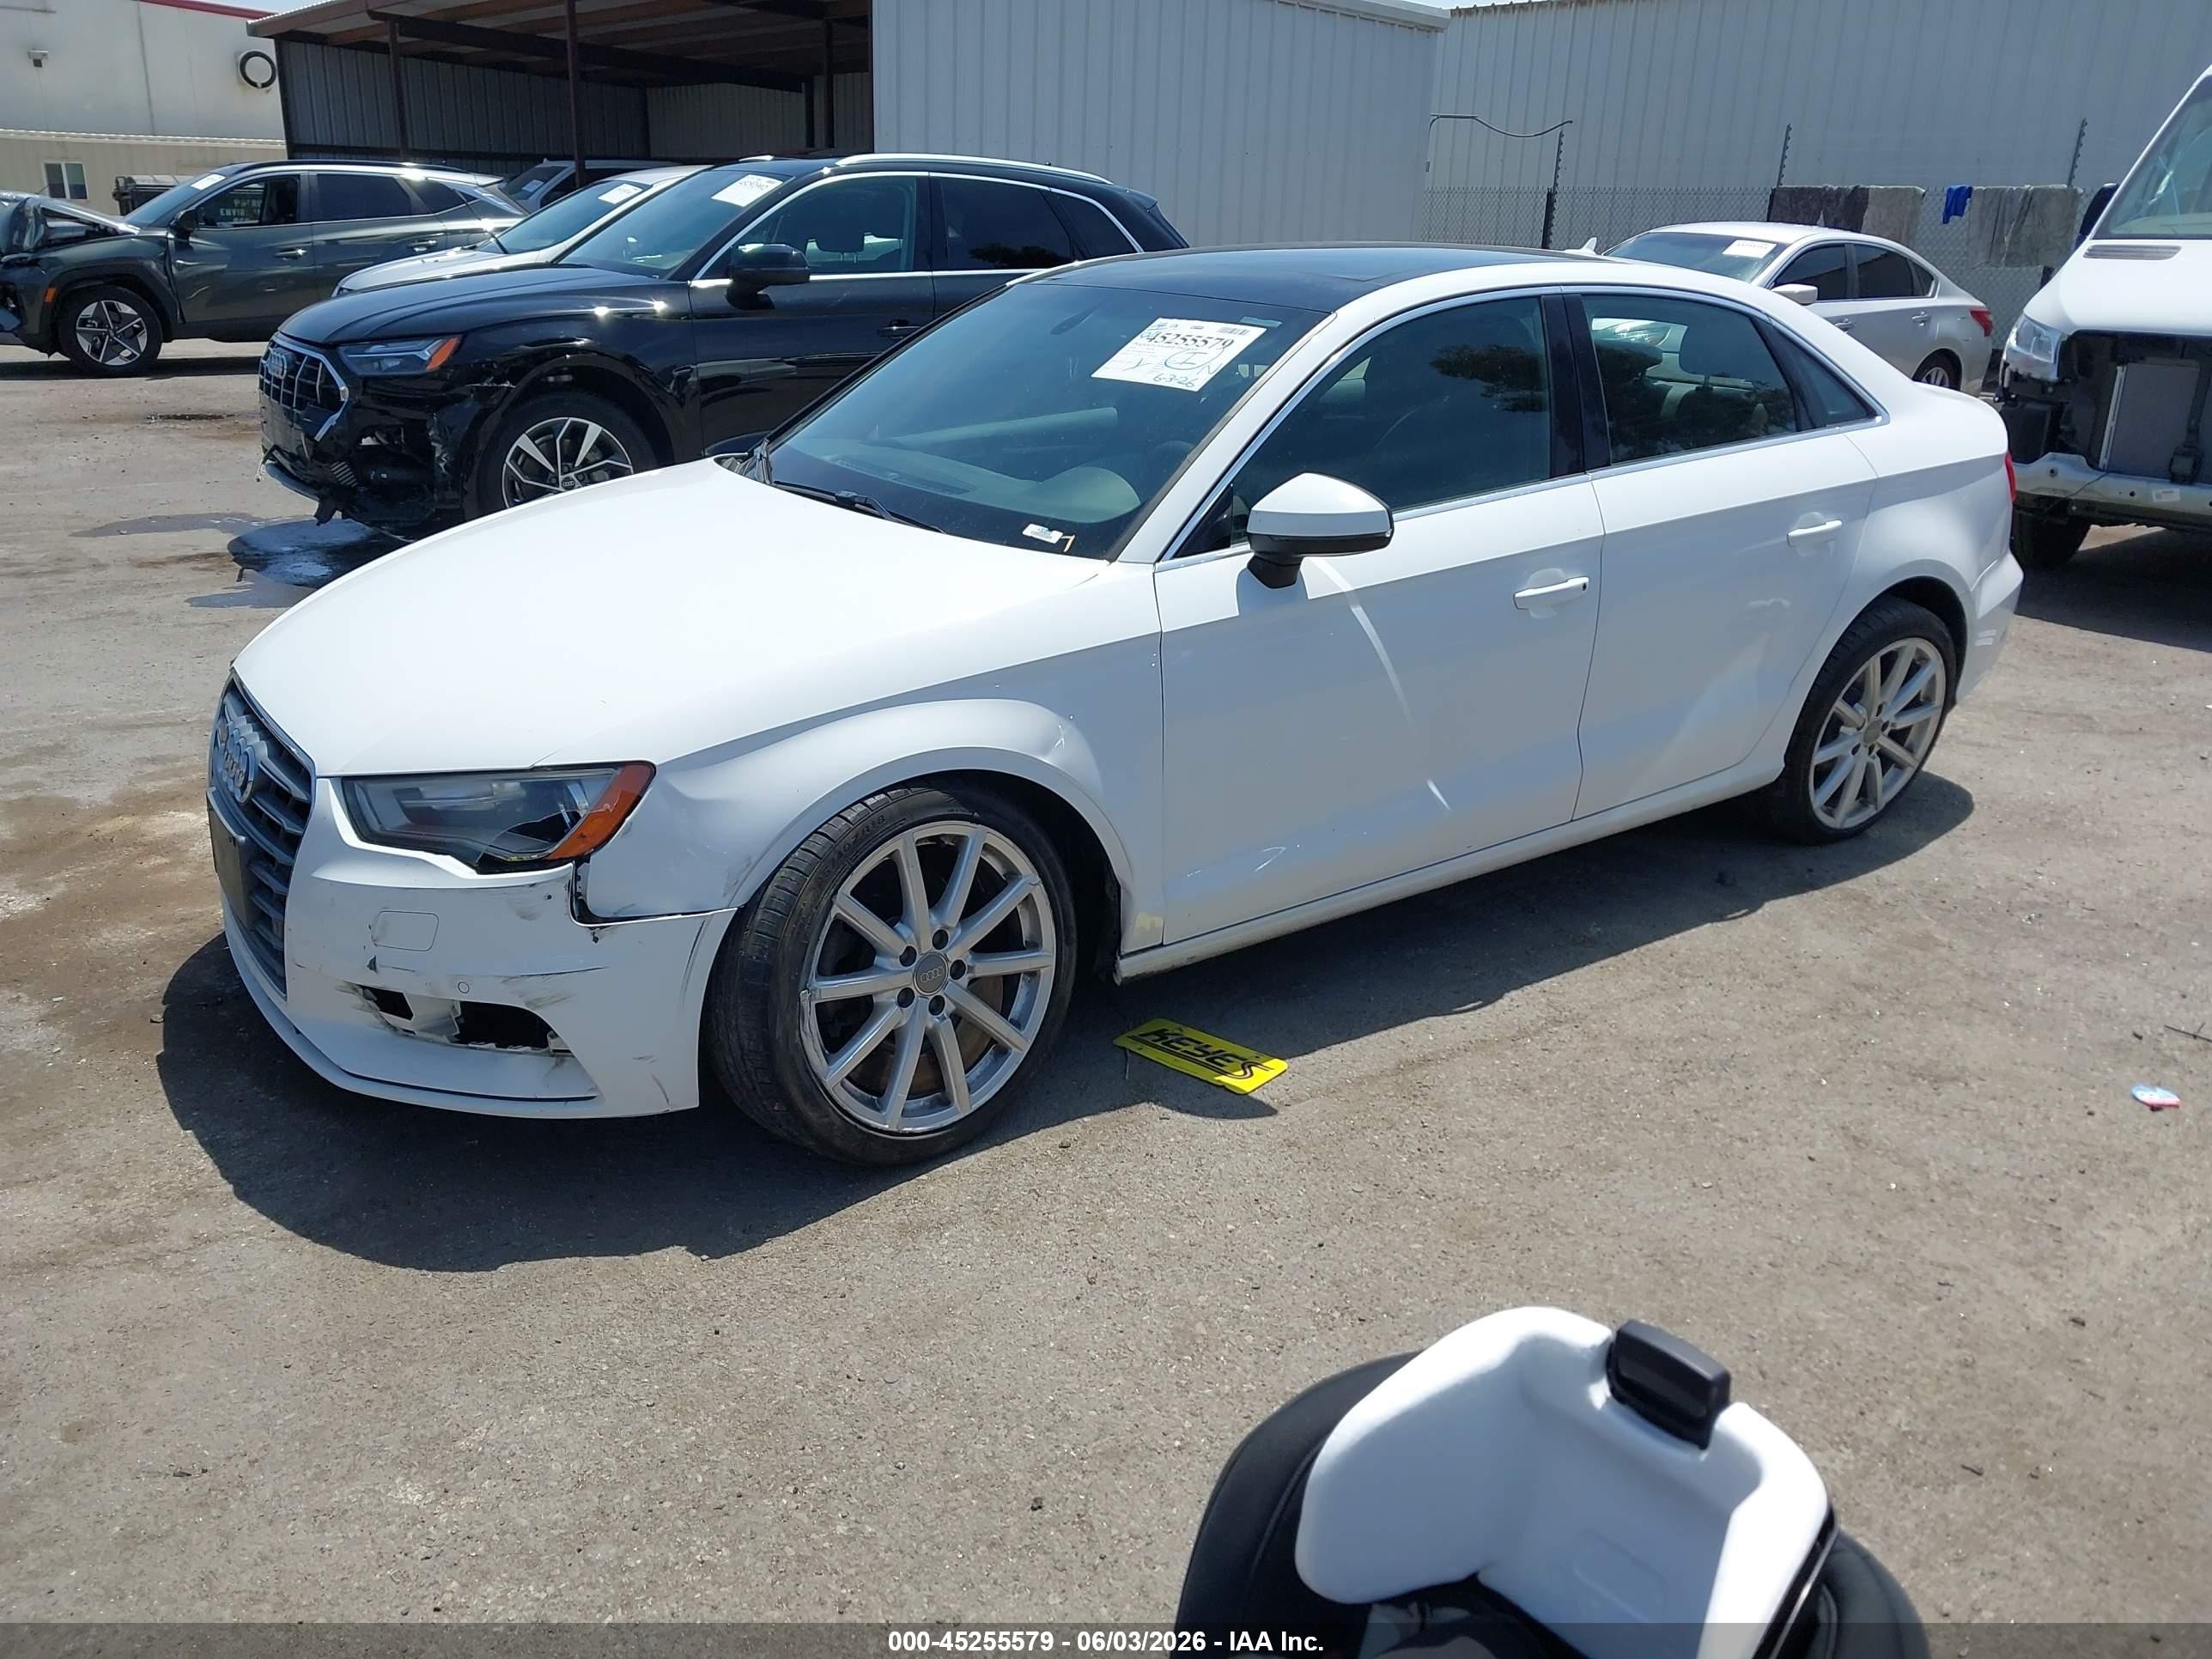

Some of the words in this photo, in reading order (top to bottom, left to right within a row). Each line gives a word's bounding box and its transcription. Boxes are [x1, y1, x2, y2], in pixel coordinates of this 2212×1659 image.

[1146, 331, 1235, 349] 45255579
[1153, 373, 1199, 388] 6-3-26
[1127, 1027, 1274, 1080] KEYES
